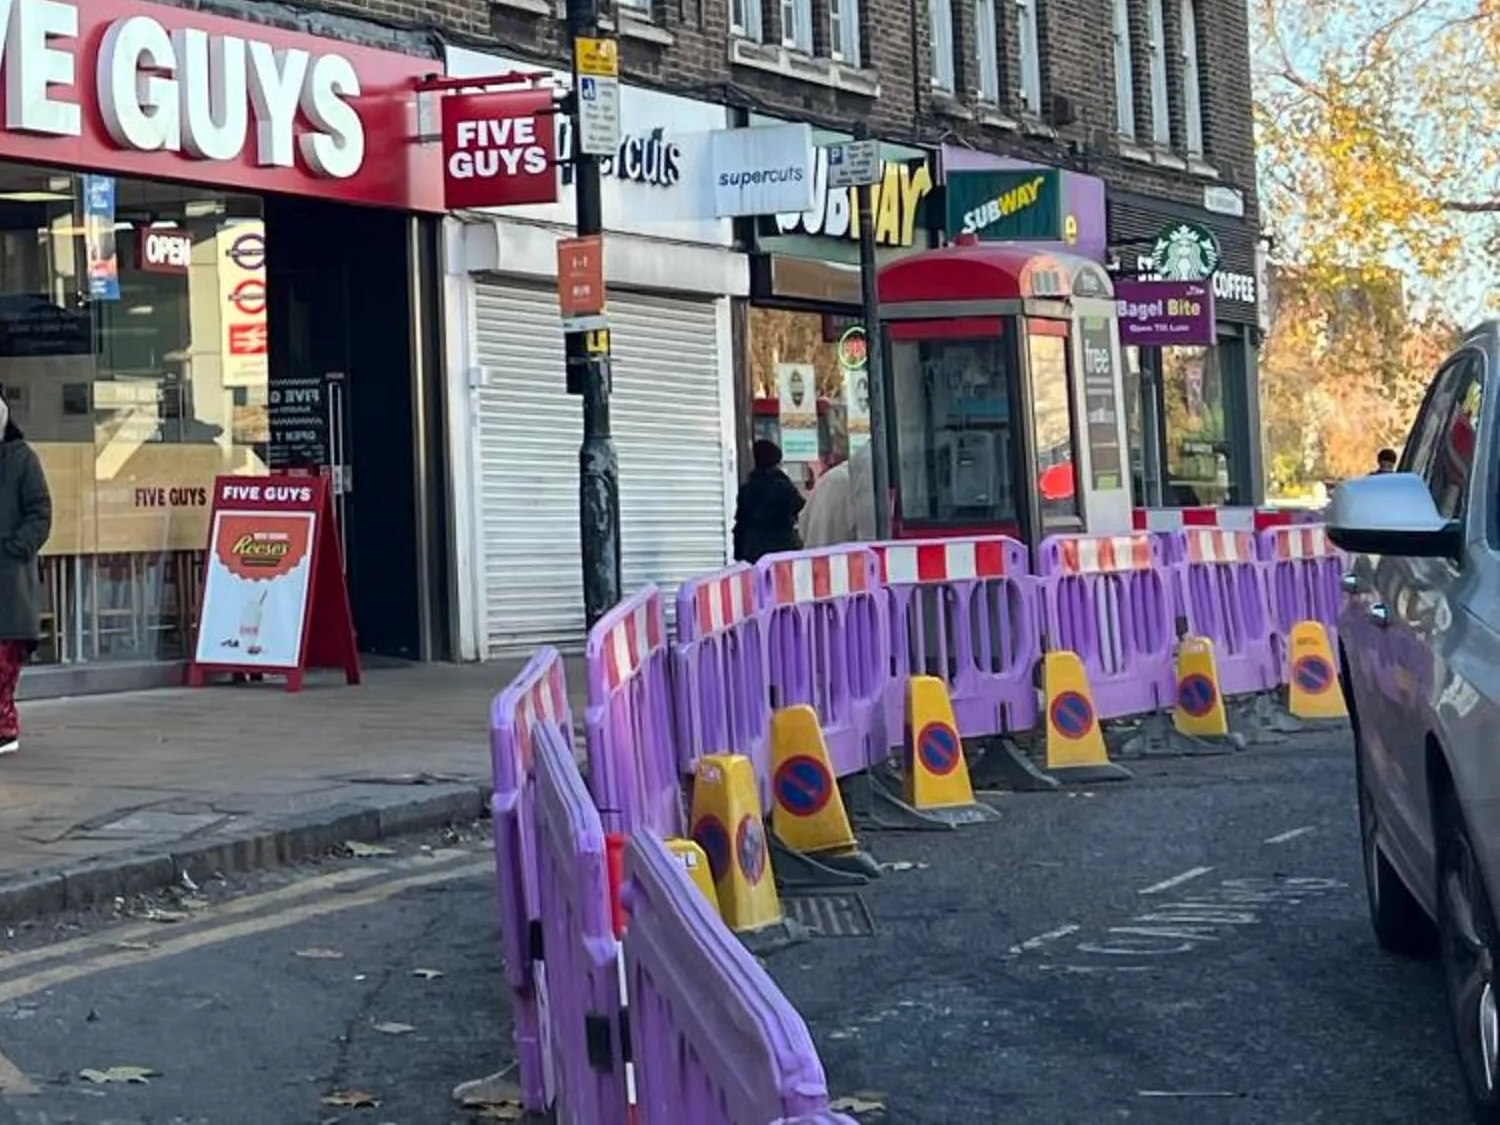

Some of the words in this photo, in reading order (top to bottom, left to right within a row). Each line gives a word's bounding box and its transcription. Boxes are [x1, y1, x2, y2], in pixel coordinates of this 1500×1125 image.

[96, 15, 366, 179] GUYS
[456, 117, 536, 149] FIVE
[448, 146, 549, 179] GUYS
[719, 166, 804, 191] supercuts
[962, 175, 1045, 234] SUBWAY
[146, 233, 191, 266] OPEN
[1212, 269, 1256, 303] COFFEE
[1117, 299, 1163, 322] Bagel
[1167, 298, 1202, 317] Bite
[1084, 338, 1110, 376] free
[134, 487, 165, 507] FIVE
[169, 487, 207, 507] GUYS
[222, 485, 260, 501] FIVE
[263, 486, 312, 502] GUYS
